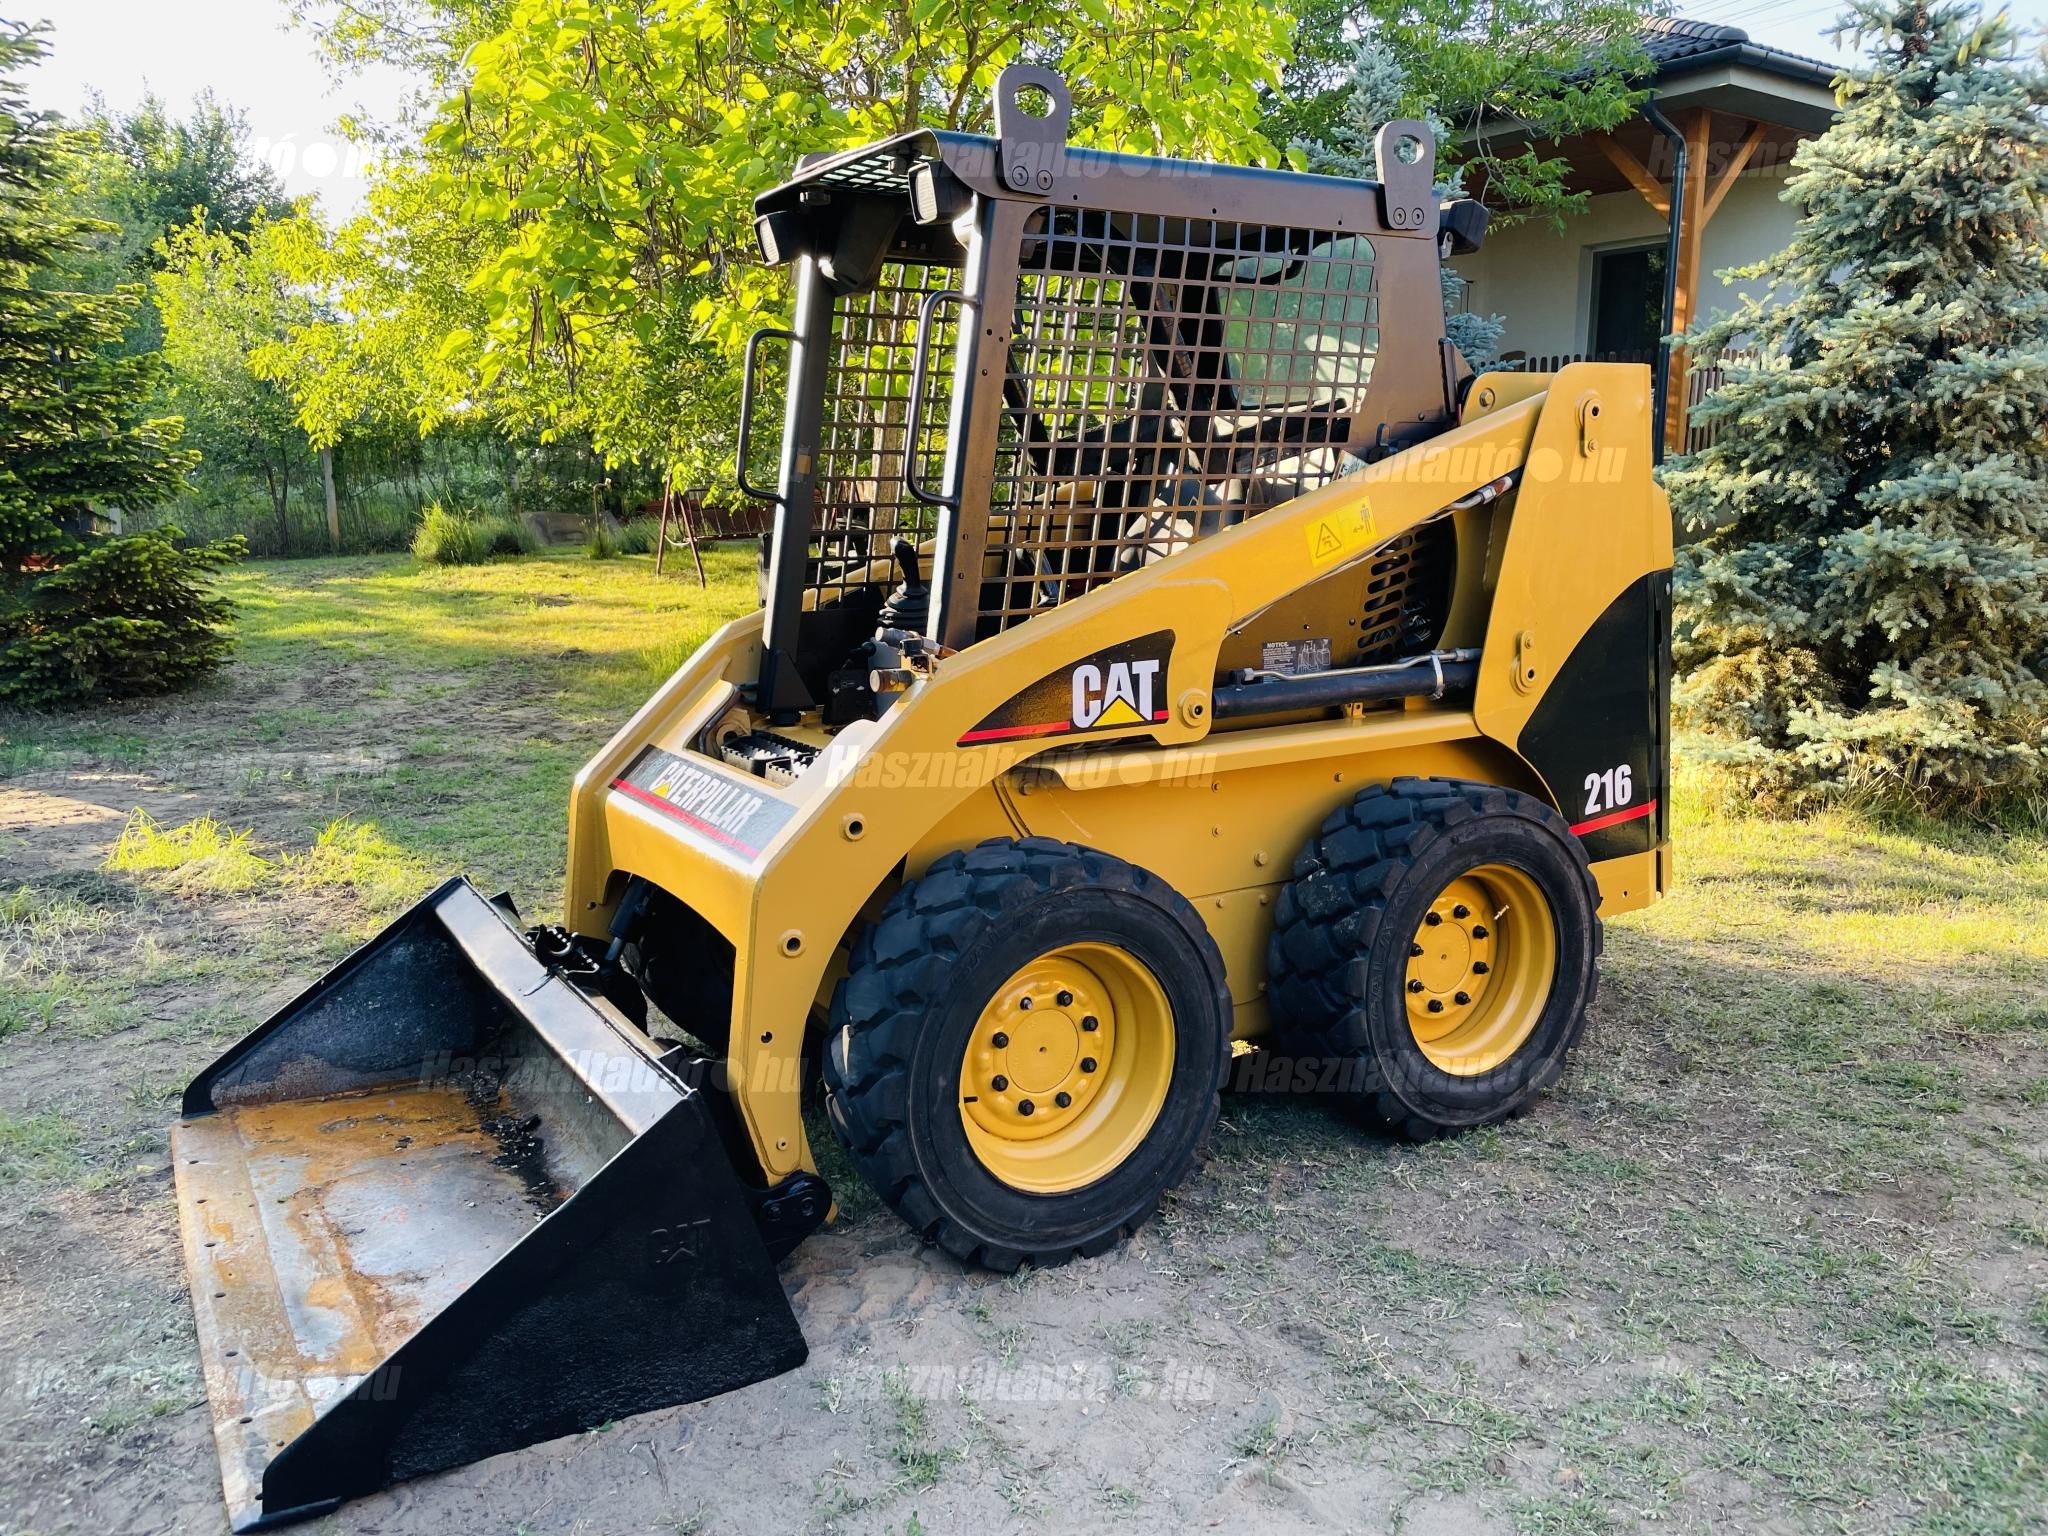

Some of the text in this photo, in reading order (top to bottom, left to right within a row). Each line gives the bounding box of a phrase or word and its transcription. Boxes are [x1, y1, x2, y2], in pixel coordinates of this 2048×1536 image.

[1072, 659, 1160, 728] CAT
[648, 760, 763, 835] CATERPILLAR
[1584, 763, 1632, 816] 216
